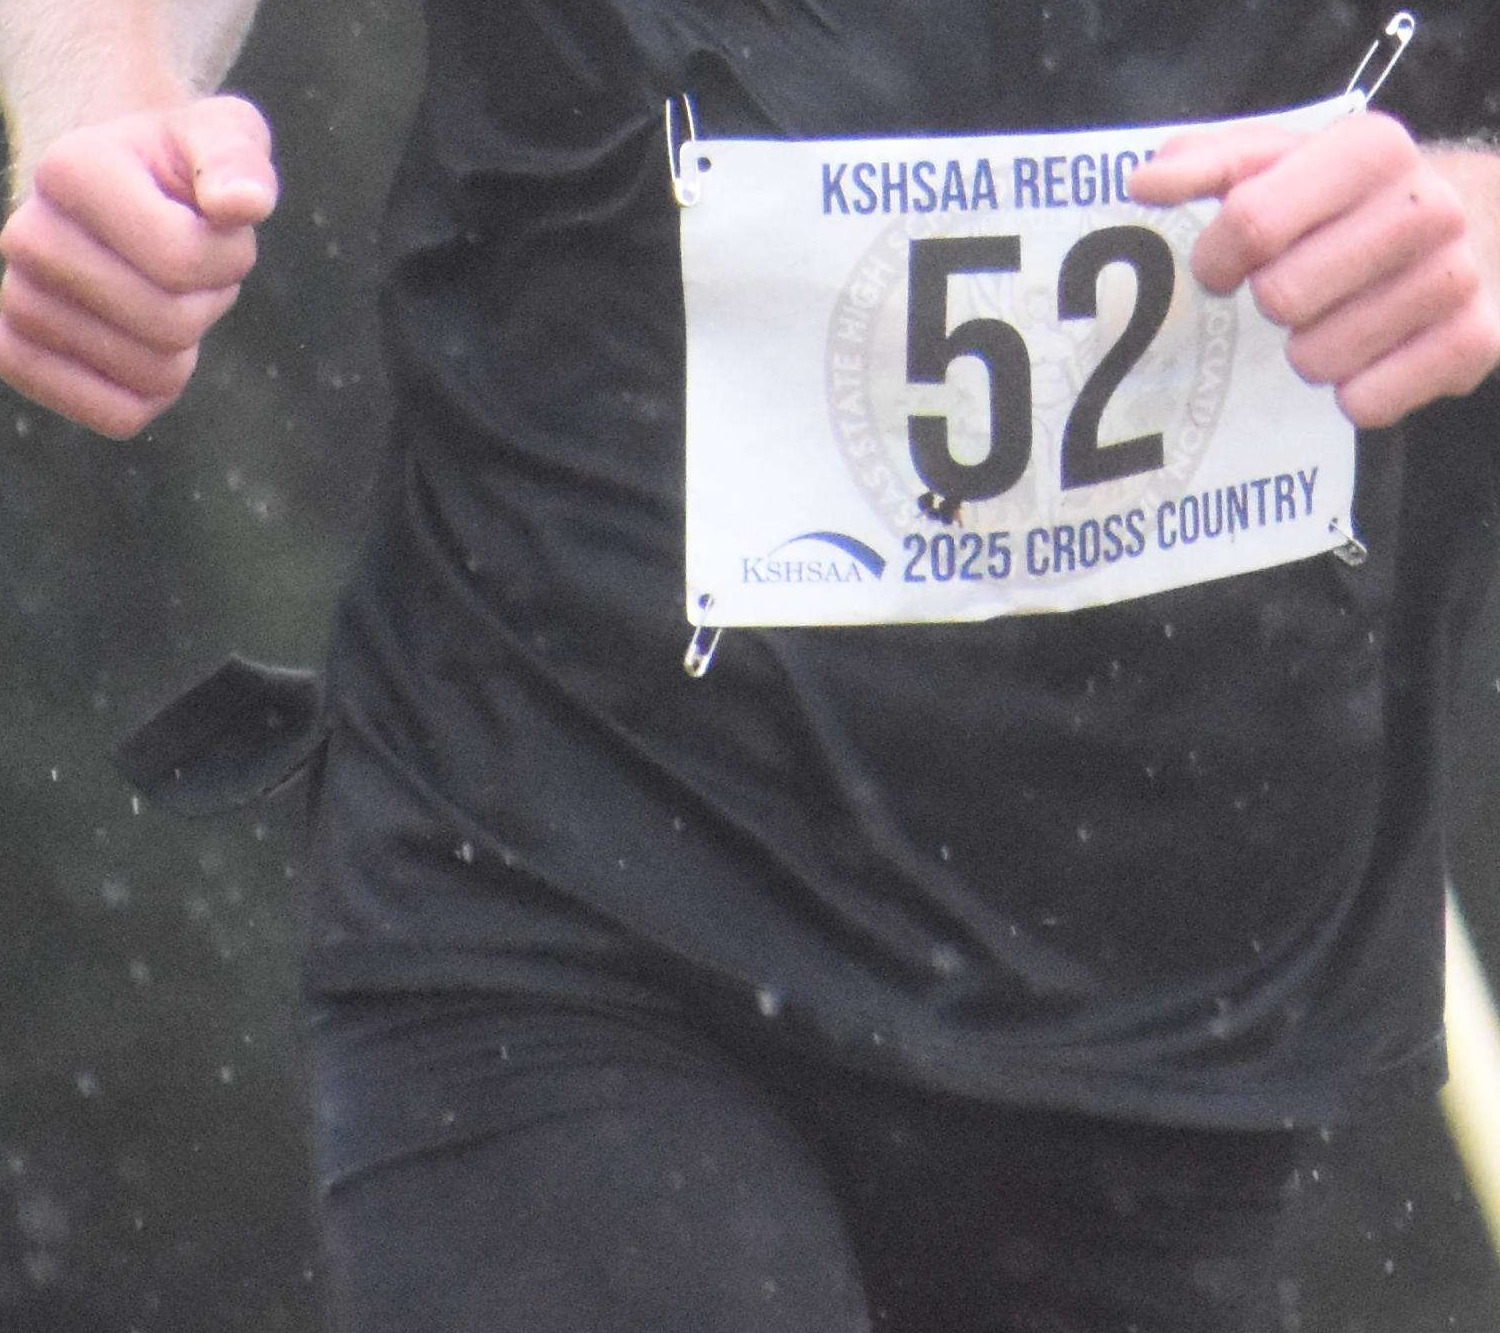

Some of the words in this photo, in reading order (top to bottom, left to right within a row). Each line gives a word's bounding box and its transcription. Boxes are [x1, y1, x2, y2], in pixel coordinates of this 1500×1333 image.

[821, 158, 999, 215] KSHSAA
[1012, 149, 1156, 210] REGIO
[905, 224, 1177, 503] 52
[741, 556, 863, 583] KSHSAA
[902, 531, 1012, 583] 2025
[1026, 508, 1146, 577] CROSS
[1157, 466, 1319, 550] COUNTRY
